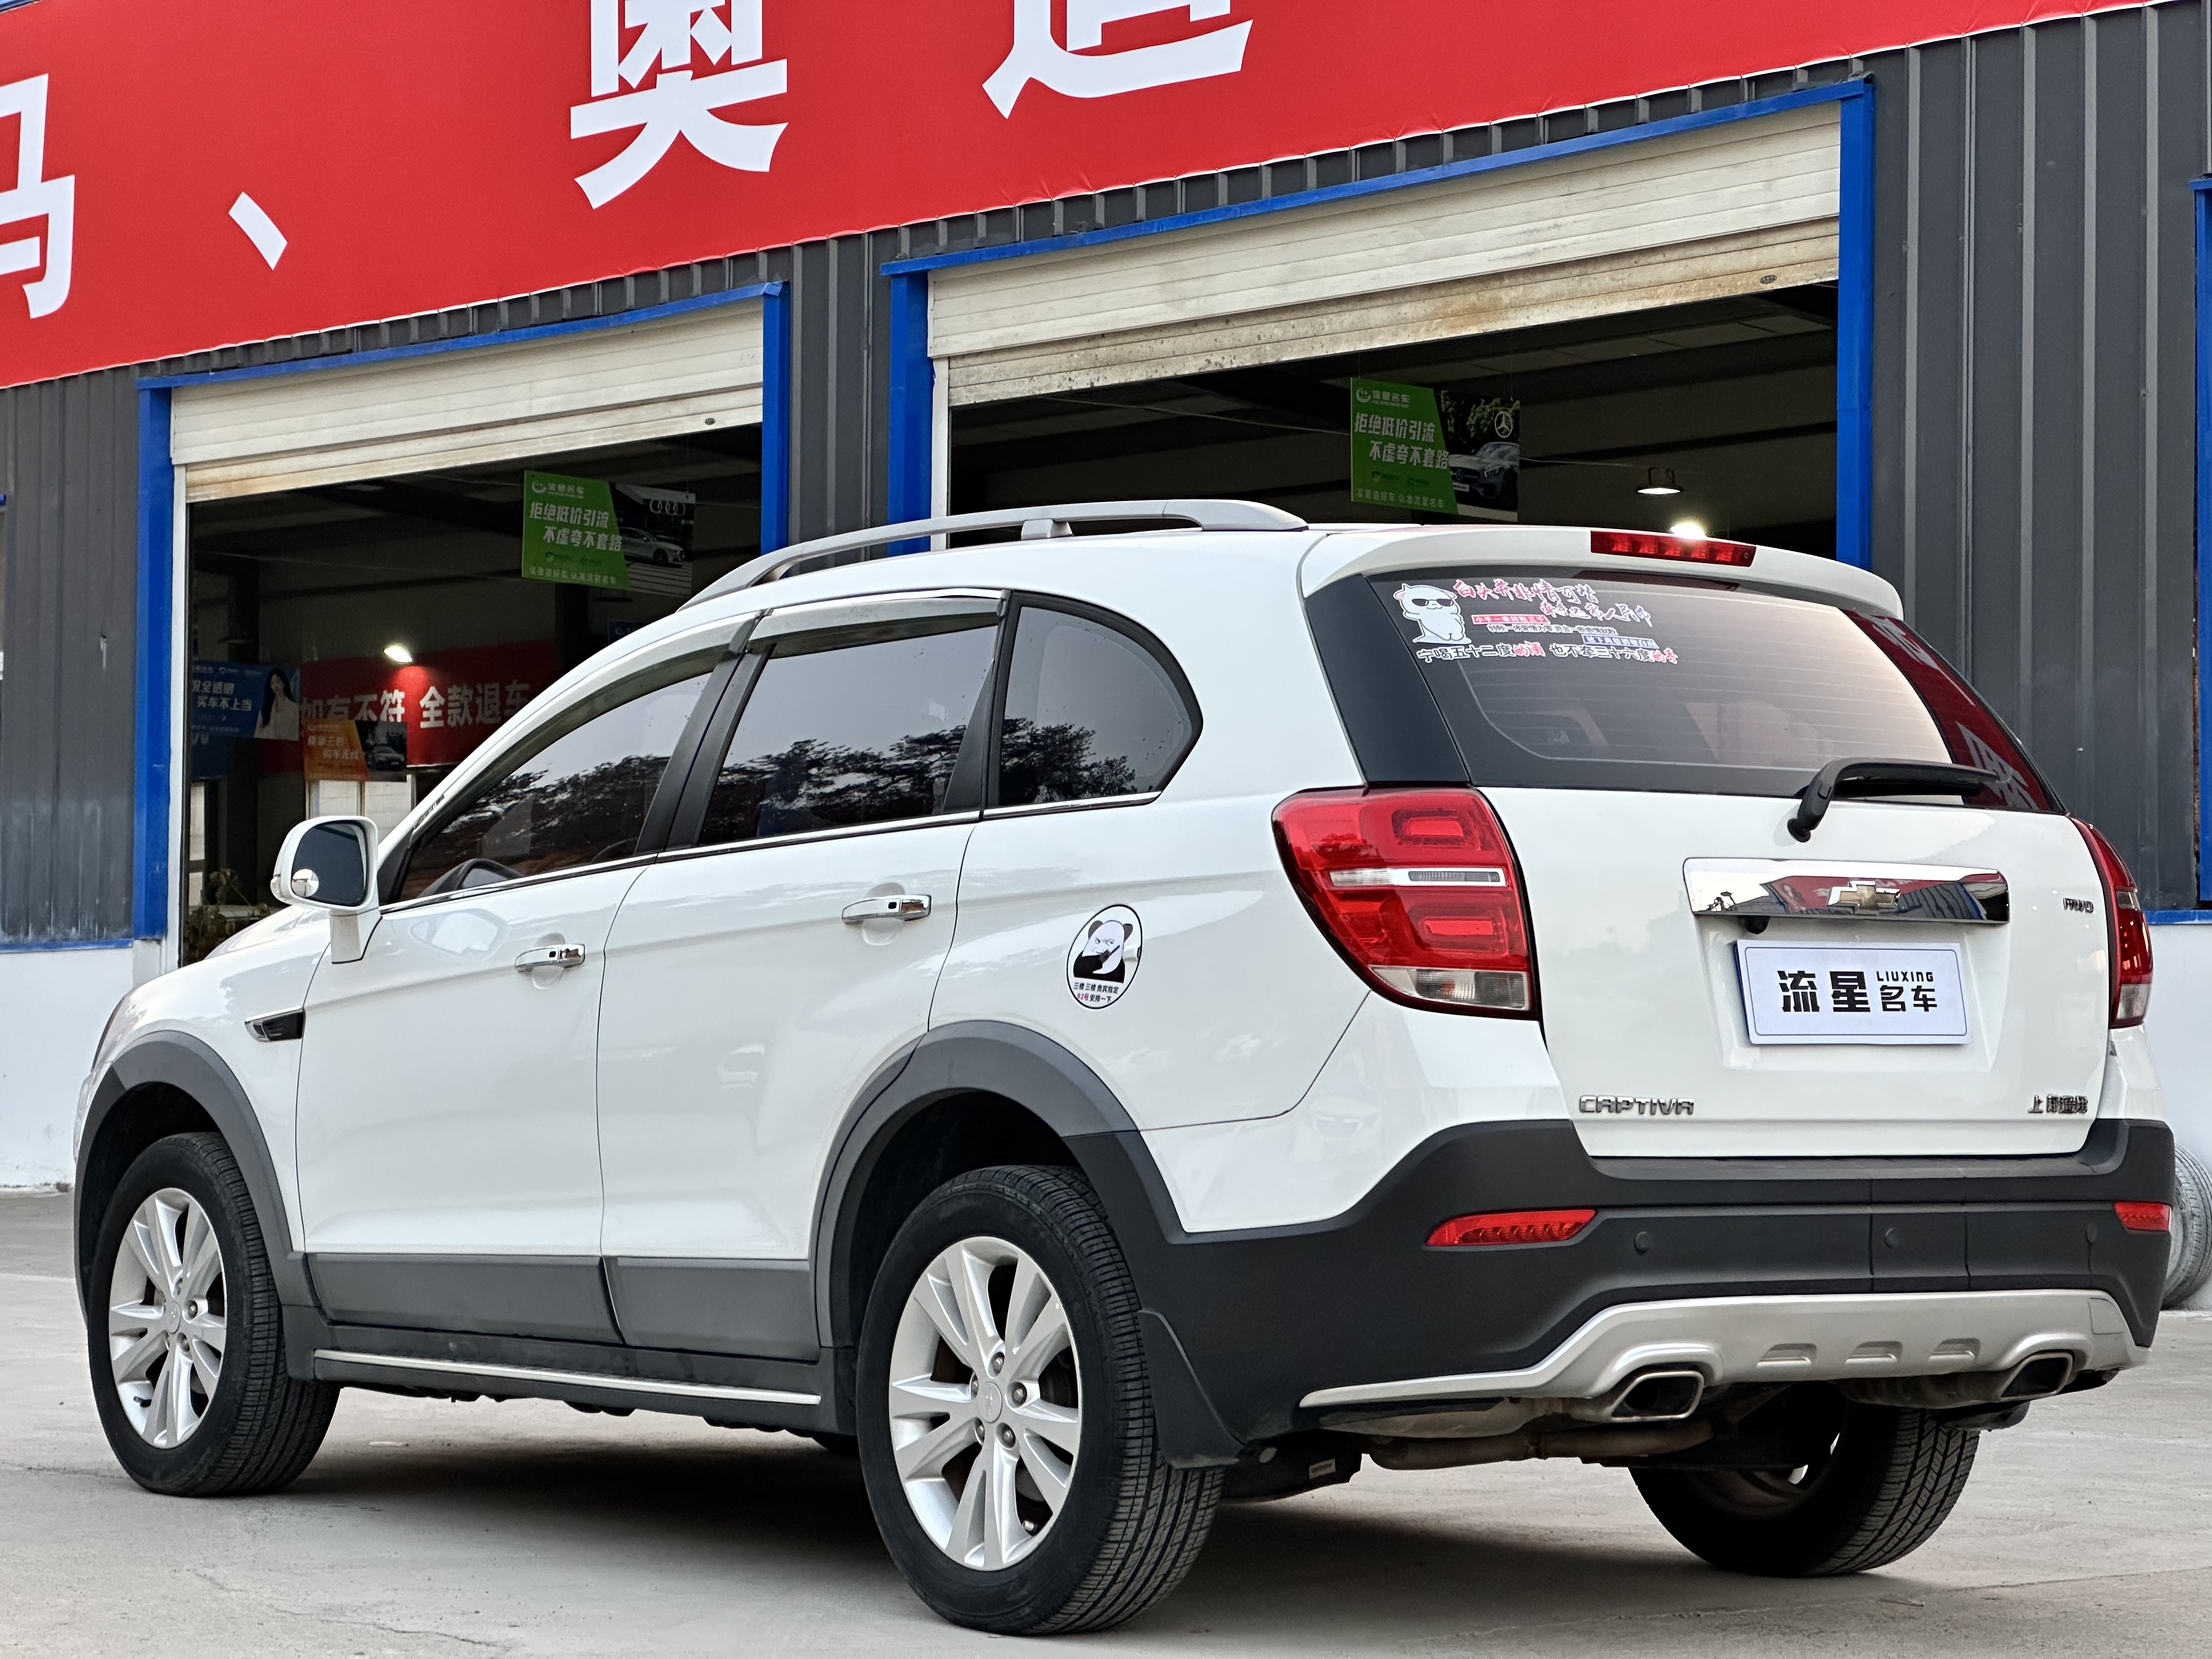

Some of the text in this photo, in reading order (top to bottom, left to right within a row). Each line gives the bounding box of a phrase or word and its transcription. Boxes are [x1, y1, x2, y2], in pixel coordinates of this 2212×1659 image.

[1355, 412, 1436, 443] 拒绝低价引流
[1369, 440, 1450, 470] 不虚夸不套路
[529, 501, 610, 528] 拒绝低价引流
[543, 526, 623, 552] 不虚夸不套路
[1416, 641, 1545, 663] 宁喝五十二度的酒
[196, 696, 252, 712] 买车不上当
[420, 680, 530, 729] 全款退车
[1877, 970, 1934, 982] LIUXING
[1579, 1096, 1694, 1115] CAPTIVA
